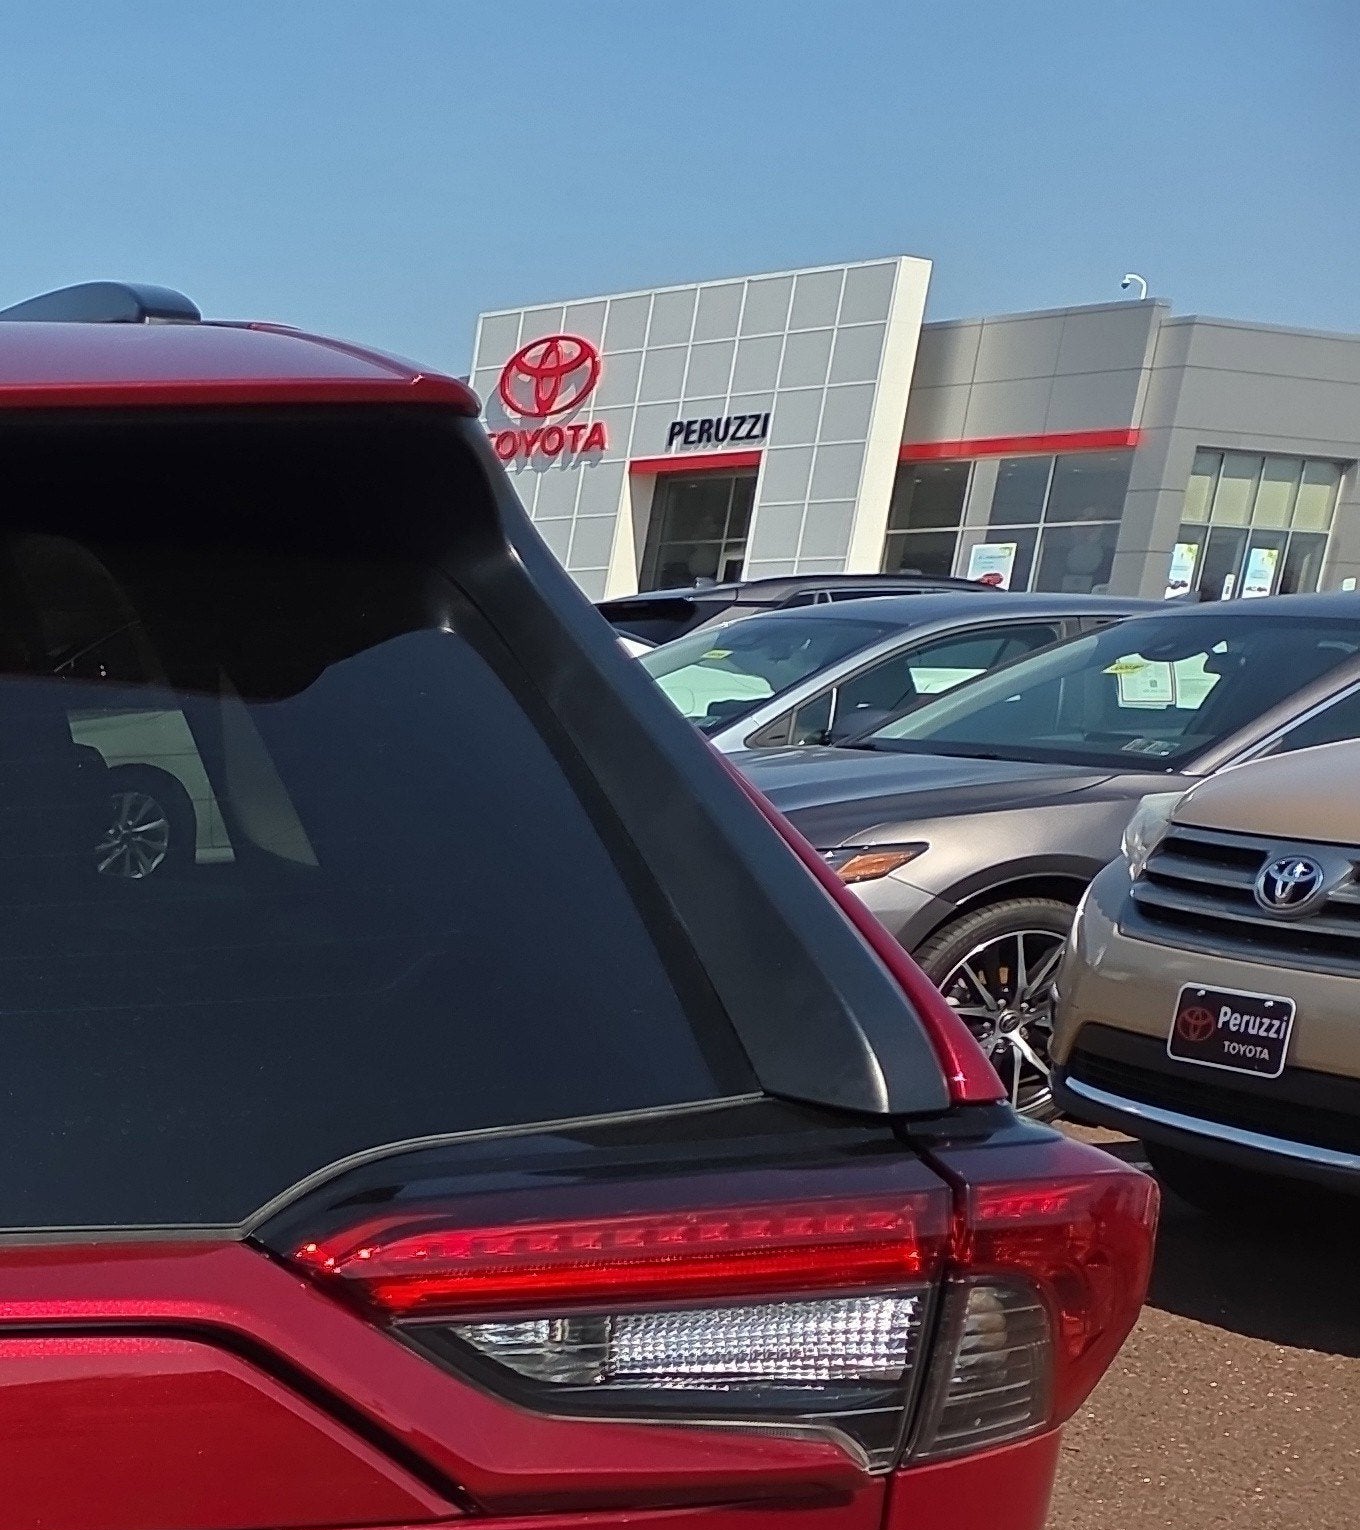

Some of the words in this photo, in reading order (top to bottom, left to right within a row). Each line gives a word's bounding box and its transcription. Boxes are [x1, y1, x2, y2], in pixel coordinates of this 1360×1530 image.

[667, 412, 772, 446] PERUZZI
[1217, 1005, 1288, 1039] Peruzzi
[1223, 1040, 1269, 1060] TOYOTA
